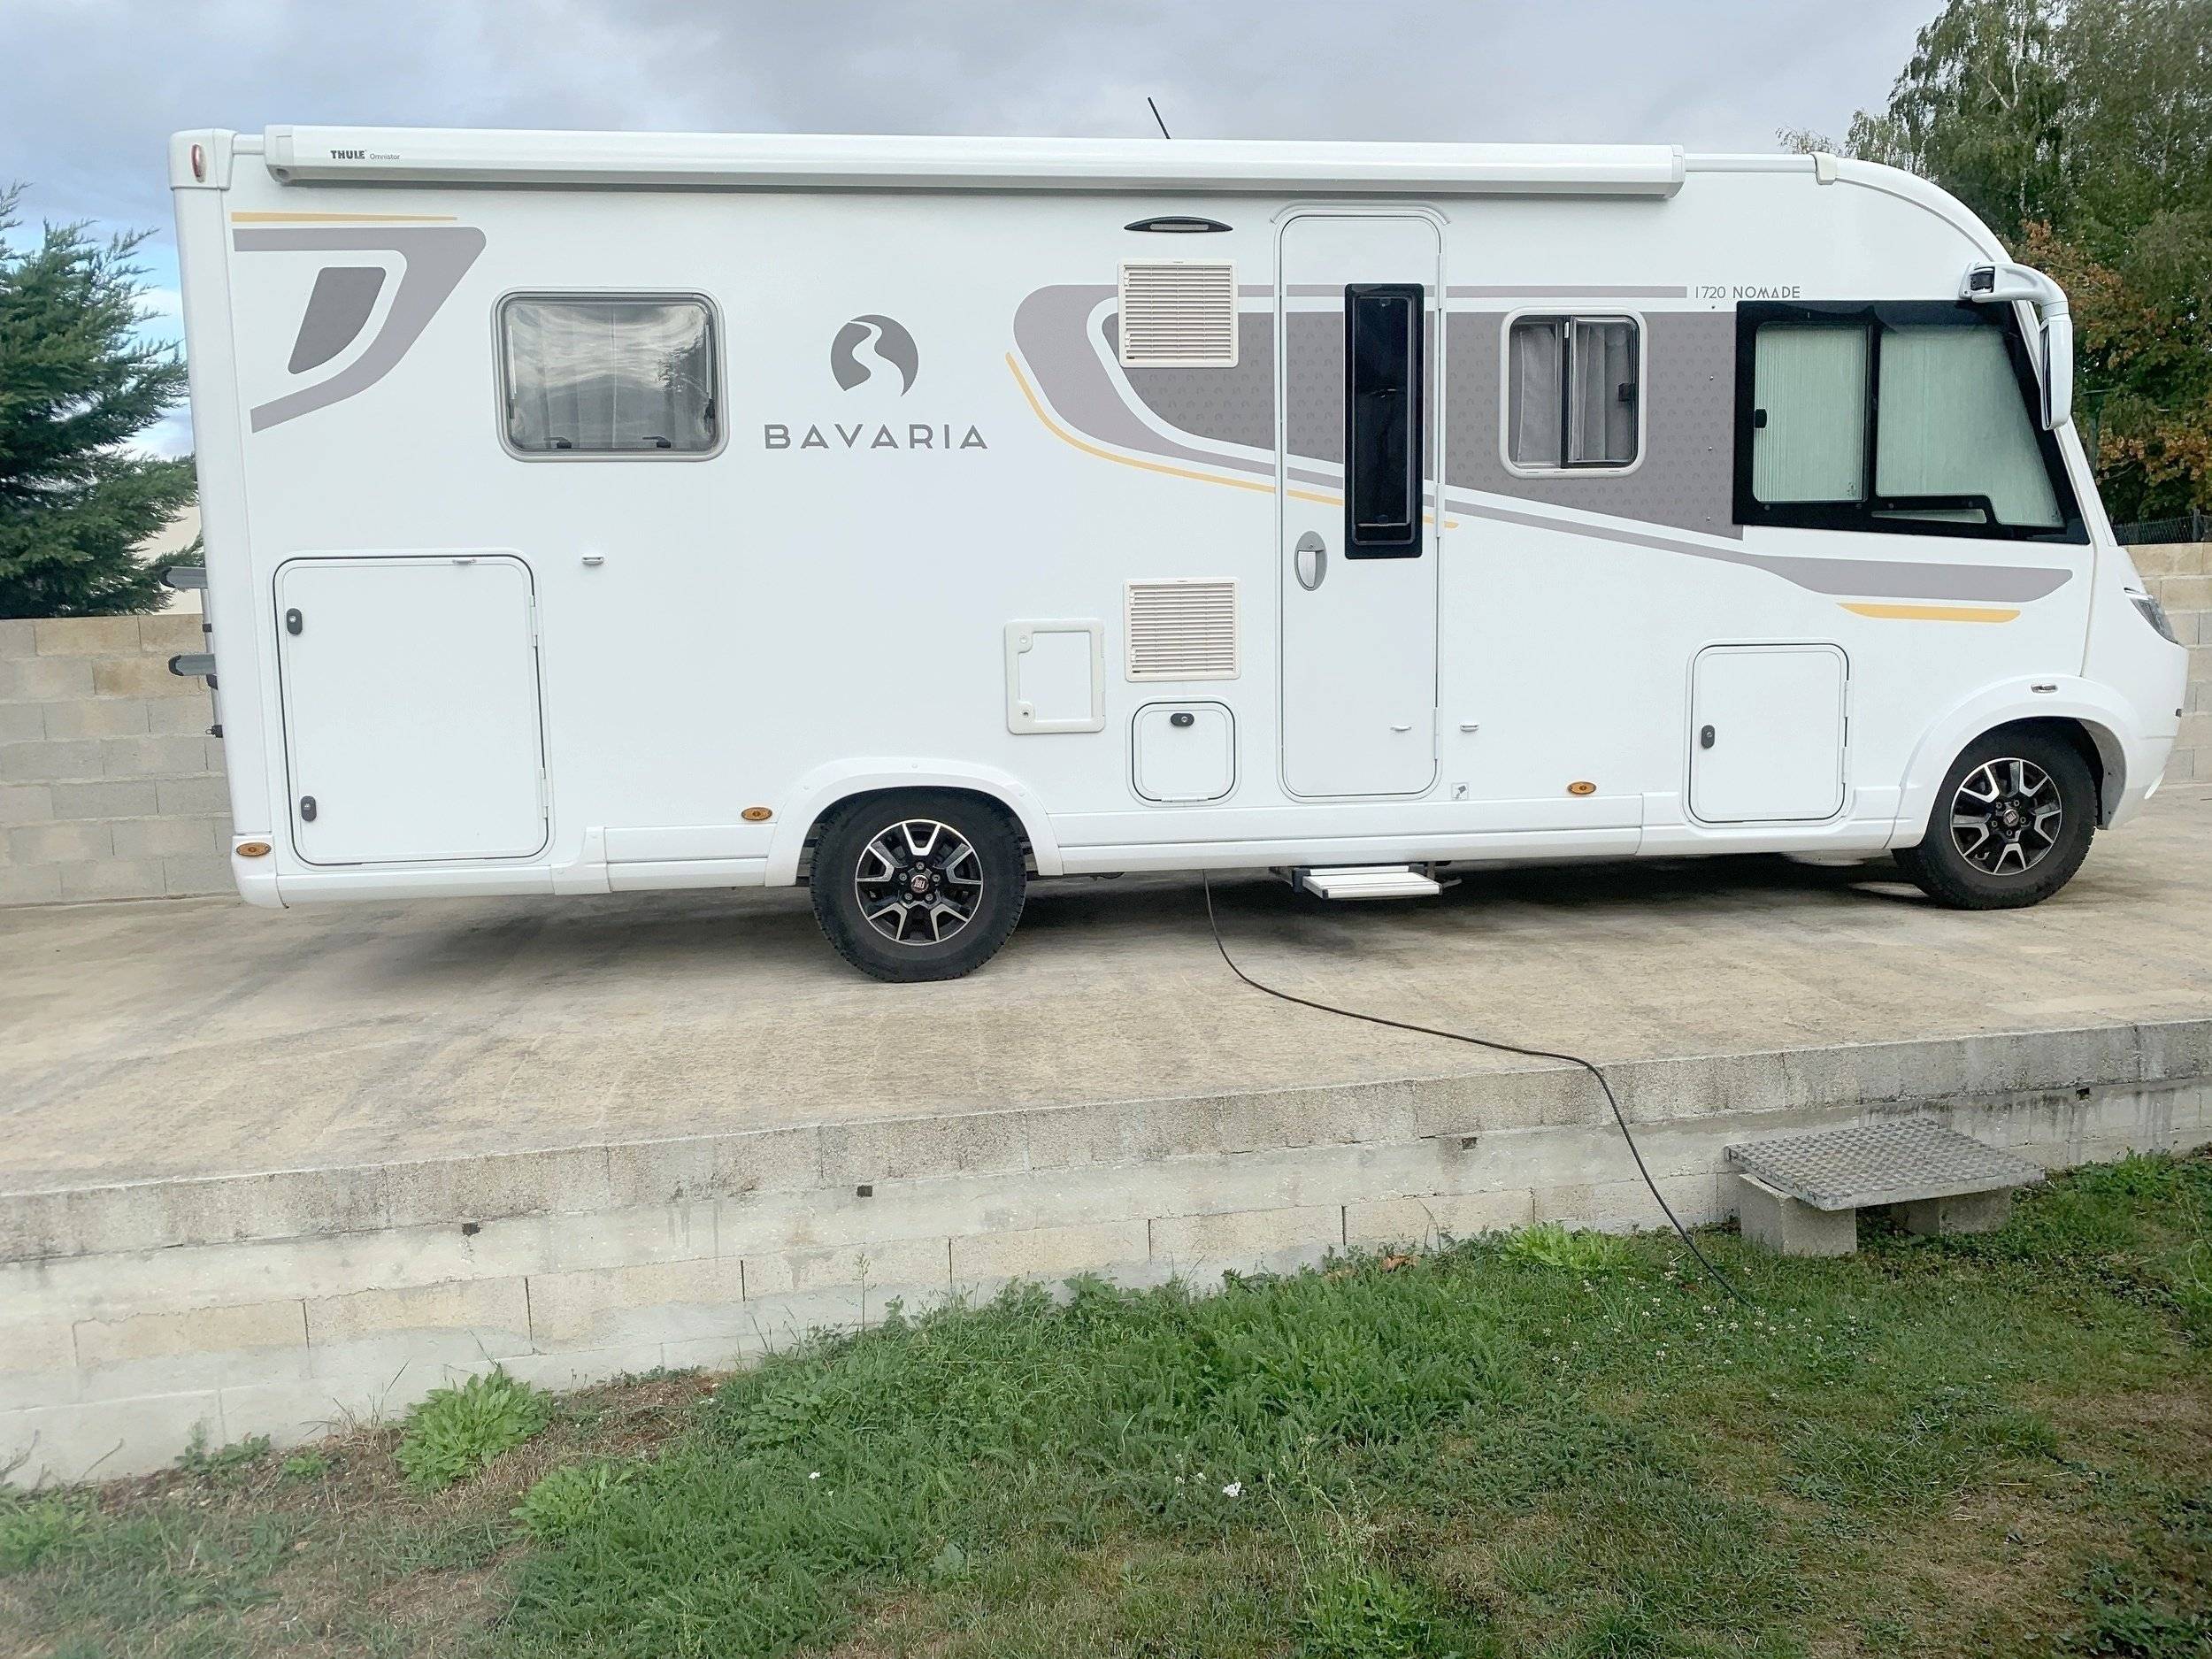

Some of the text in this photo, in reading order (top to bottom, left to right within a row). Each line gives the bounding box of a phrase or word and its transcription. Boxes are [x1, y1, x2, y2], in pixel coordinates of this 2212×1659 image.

[330, 150, 365, 159] THULE
[1732, 286, 1801, 299] NOMADE
[764, 423, 988, 449] BAVARIA
